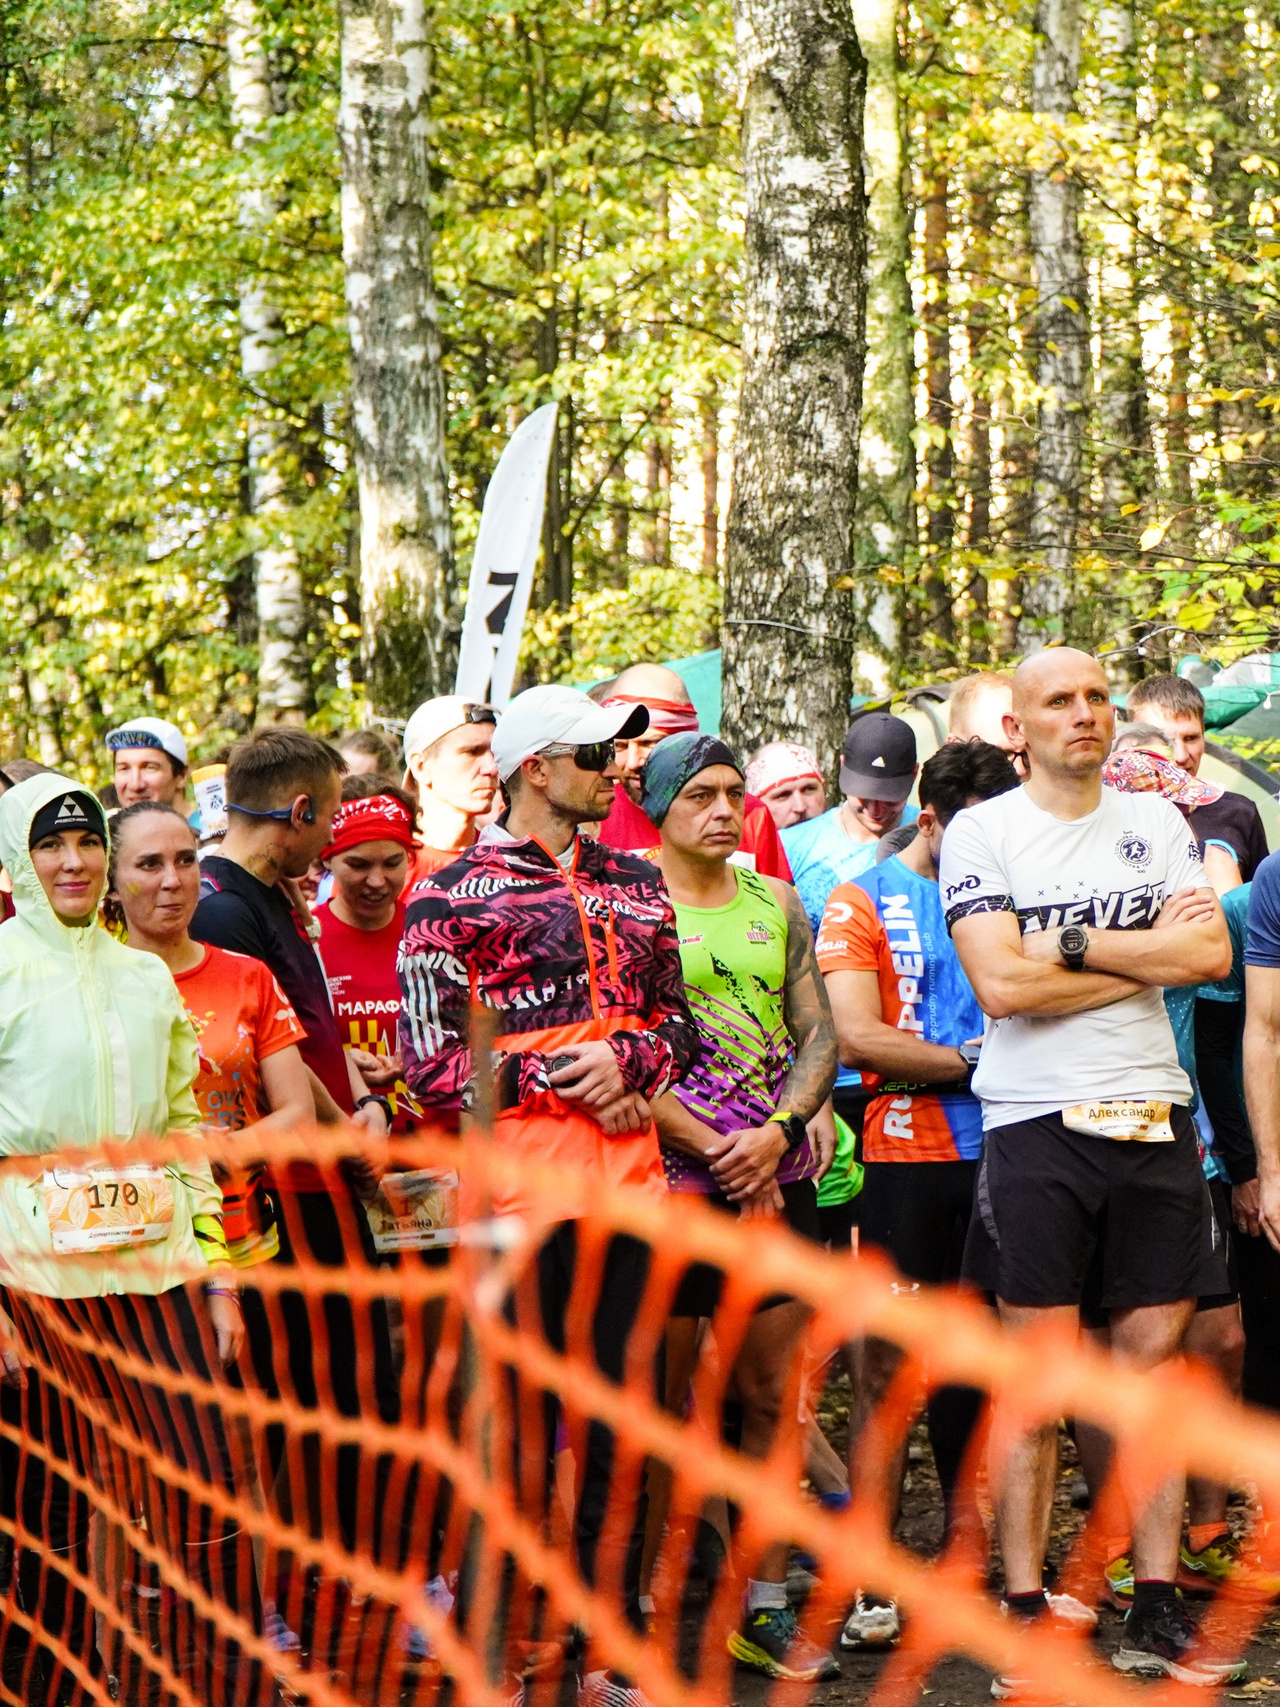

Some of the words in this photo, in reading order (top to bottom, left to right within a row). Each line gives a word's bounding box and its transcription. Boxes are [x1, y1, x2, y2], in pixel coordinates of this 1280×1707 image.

[923, 931, 934, 952] club
[880, 894, 925, 1041] PPELIN
[928, 953, 937, 991] running
[1089, 1108, 1156, 1121] Александр
[87, 1182, 139, 1209] 170
